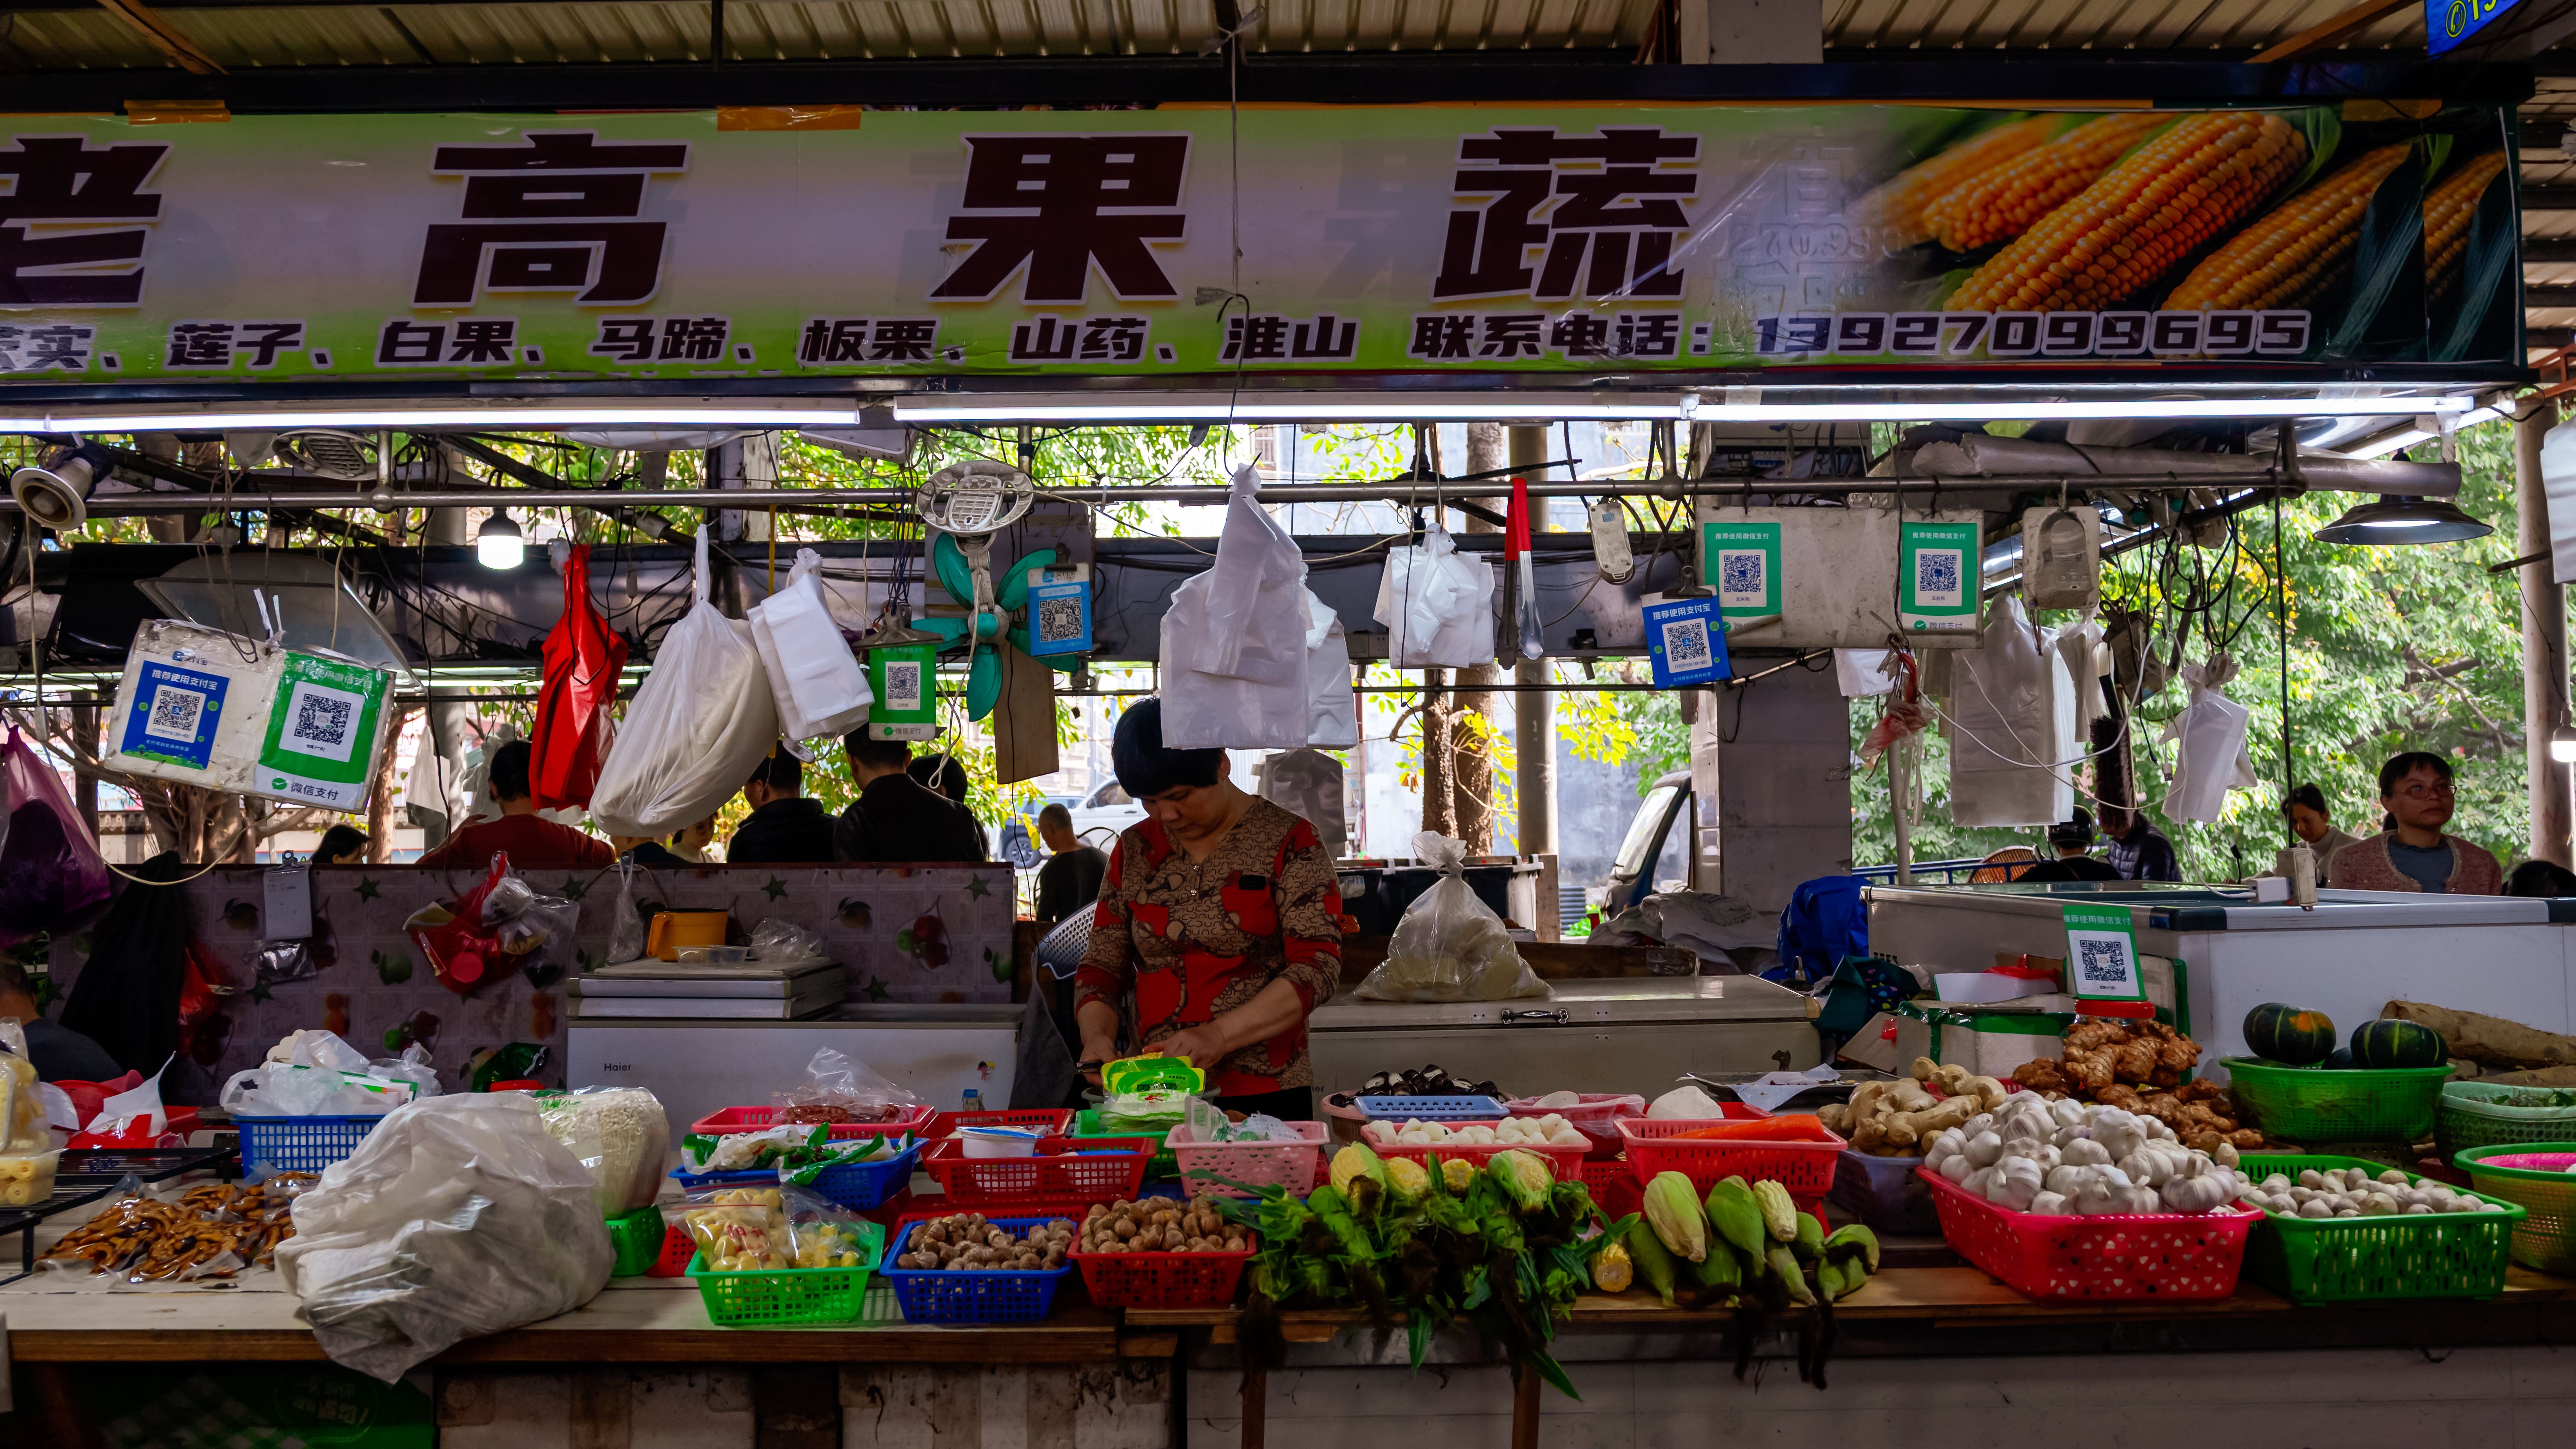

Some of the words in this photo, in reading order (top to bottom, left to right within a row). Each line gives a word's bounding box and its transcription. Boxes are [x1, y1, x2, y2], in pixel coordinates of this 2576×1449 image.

[1653, 603, 1711, 620] 推荐使用支付宝
[1929, 622, 1963, 630] 微信支付
[152, 669, 218, 690] 推荐使用支付宝
[290, 782, 339, 800] 微信支付
[604, 1062, 631, 1071] Haier
